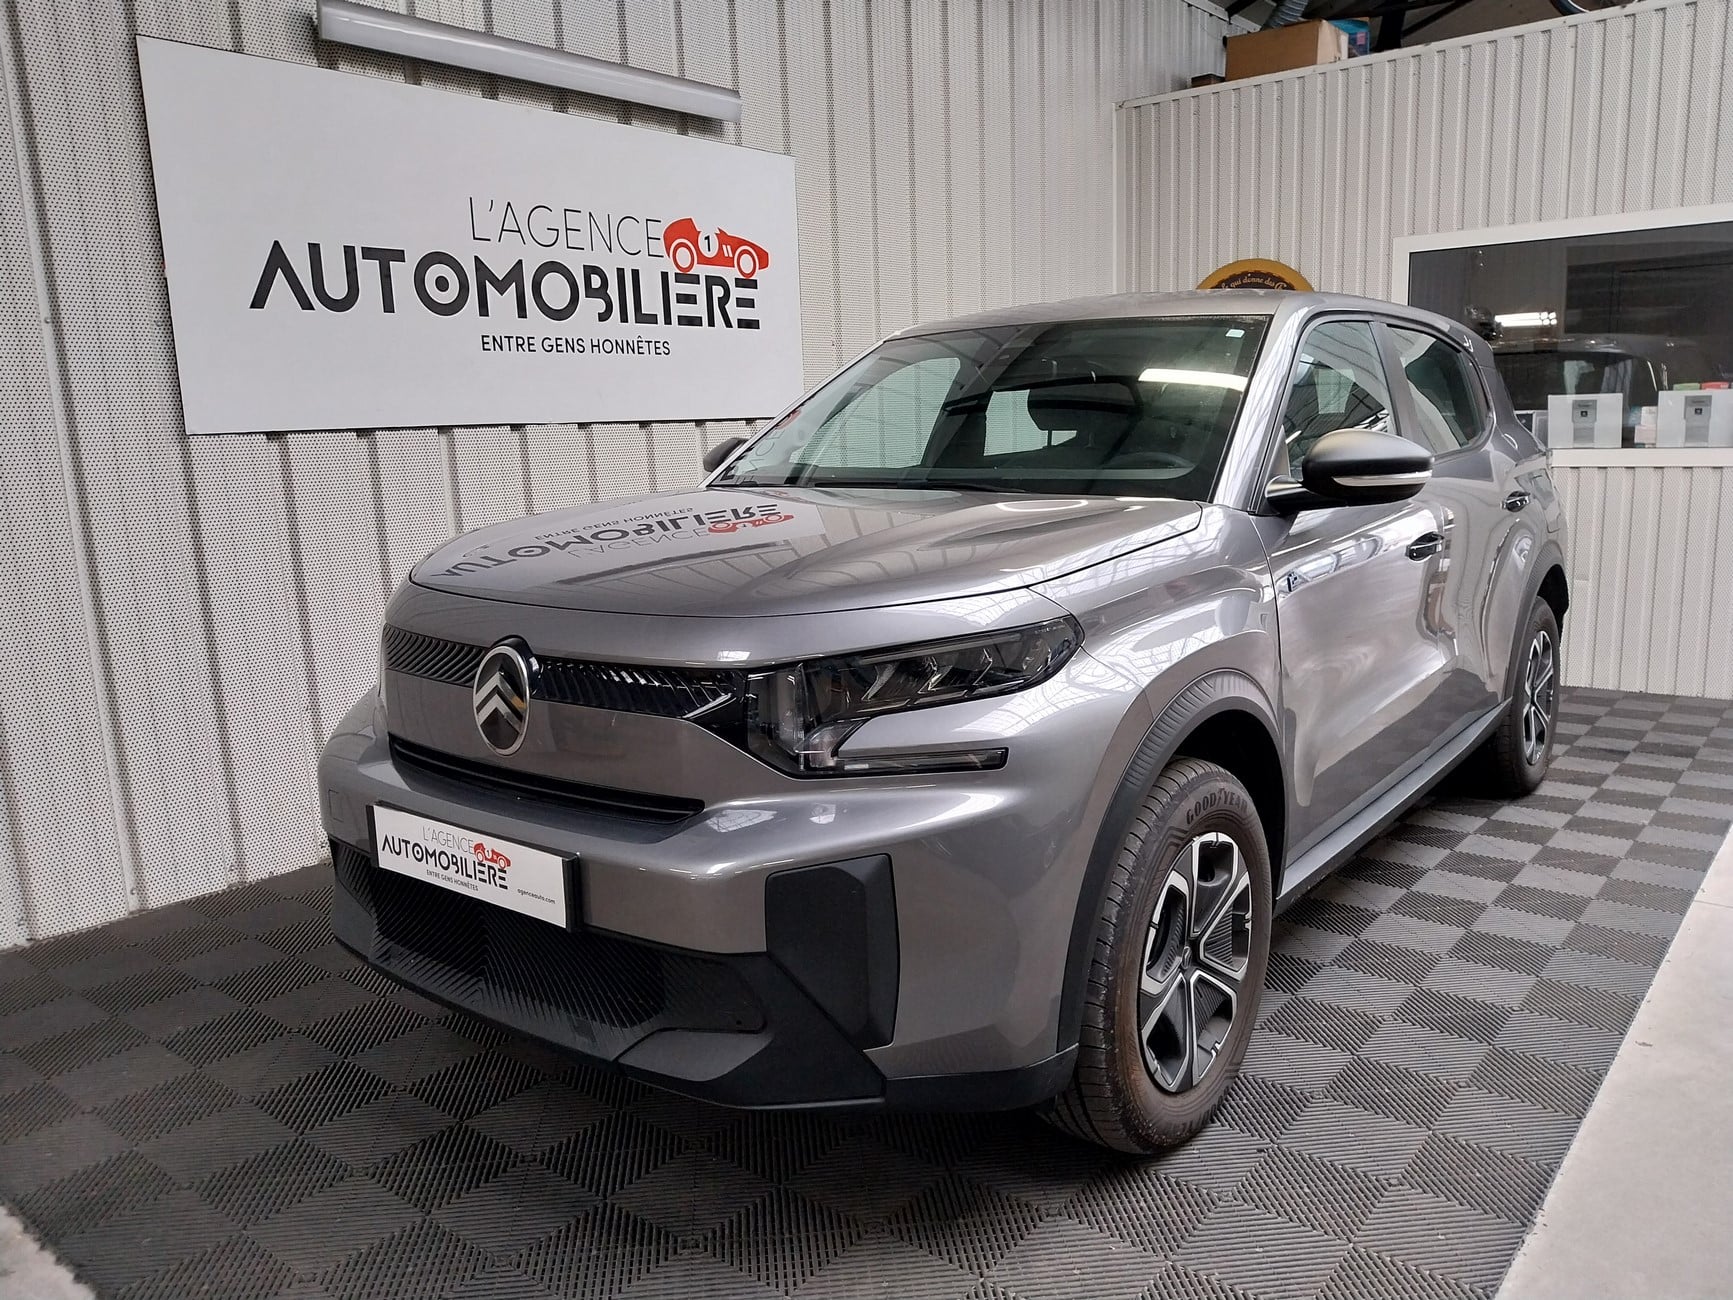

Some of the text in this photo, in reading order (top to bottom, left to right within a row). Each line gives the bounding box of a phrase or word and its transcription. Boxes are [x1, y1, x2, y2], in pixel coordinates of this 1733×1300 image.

[469, 197, 664, 258] L'AGENCE
[704, 234, 711, 252] 1
[481, 335, 671, 356] ENTRE GENS HONNÊTES
[1186, 788, 1248, 825] GOODYEAR
[423, 826, 474, 854] L'AGENCE
[426, 869, 441, 879] ENTRE
[441, 874, 453, 883] GENS
